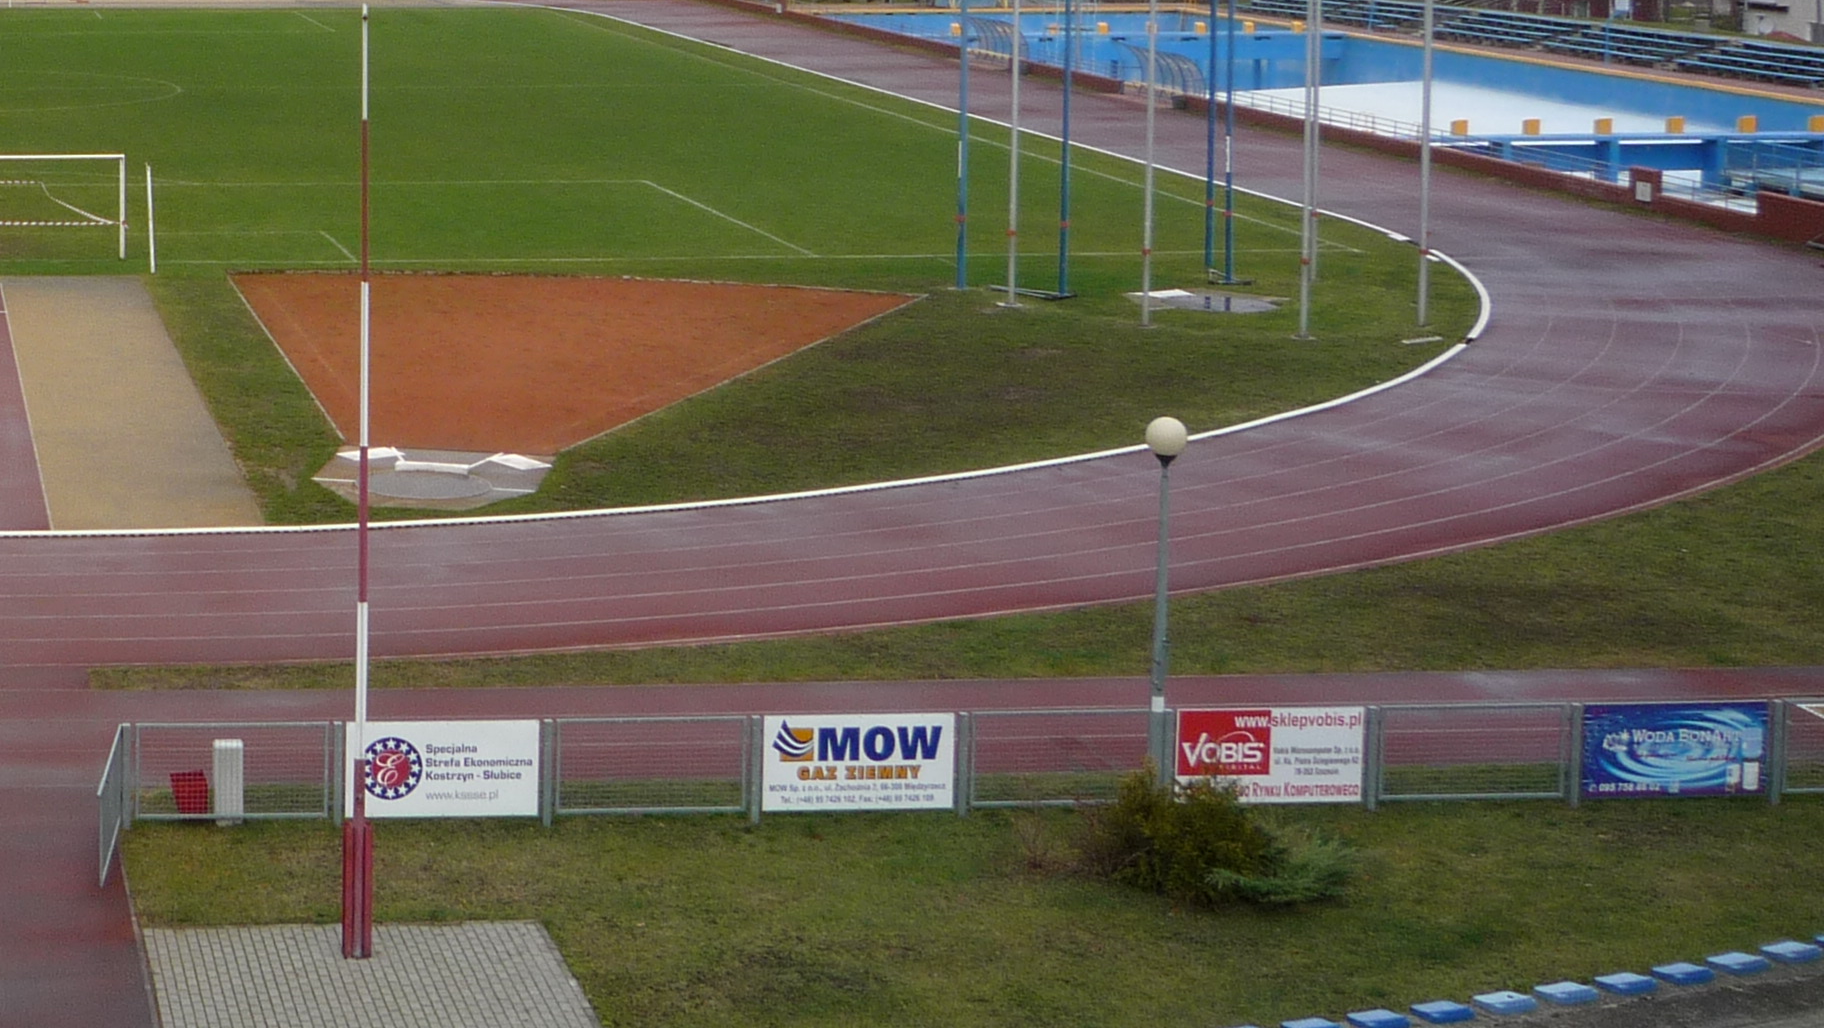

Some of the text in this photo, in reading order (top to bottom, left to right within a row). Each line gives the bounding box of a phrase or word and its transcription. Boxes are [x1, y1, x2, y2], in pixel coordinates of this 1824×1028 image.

[1235, 712, 1362, 730] www.sklepvobis.pl
[1632, 729, 1674, 742] WODA
[426, 744, 478, 756] Specjalna
[818, 726, 942, 762] MOW
[1182, 732, 1264, 768] VOBIS
[426, 756, 533, 768] Strefa Ekonomiczna
[426, 771, 474, 782] Kostrzyn
[484, 770, 522, 780] Słubice
[797, 764, 921, 780] GAZ ZIEMNY
[1252, 782, 1281, 797] RYNKU
[1284, 782, 1359, 796] KOMPUTEROWEGO
